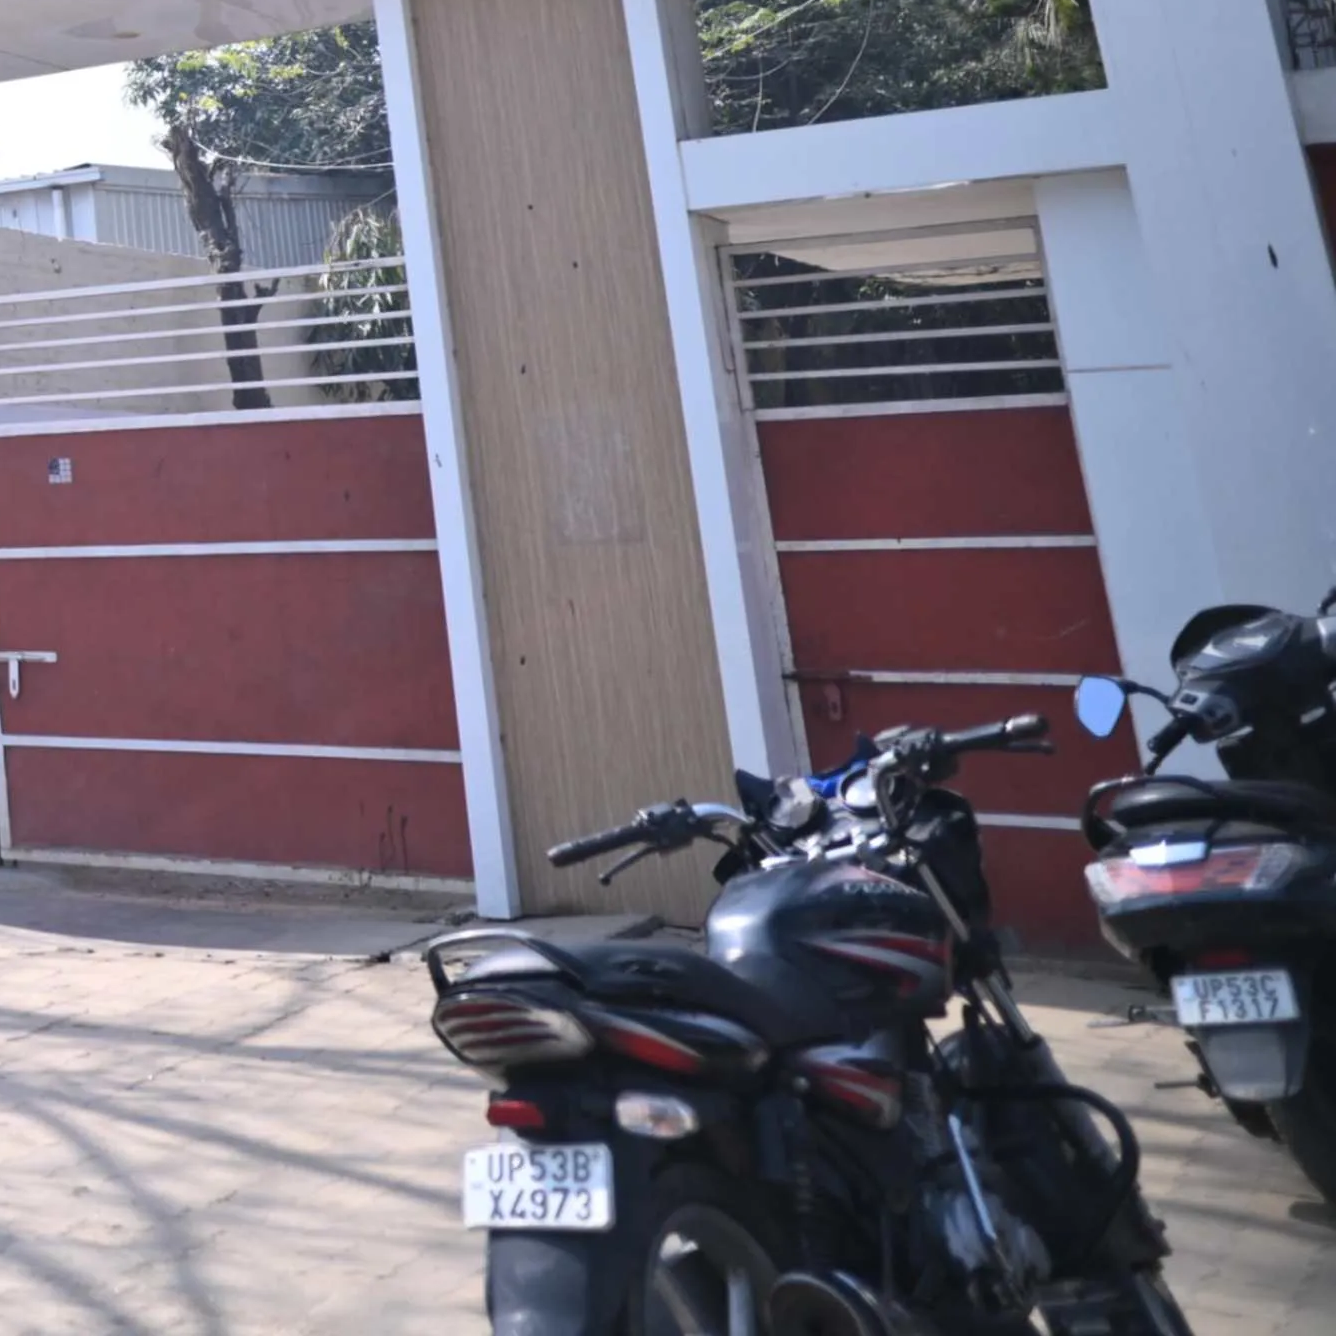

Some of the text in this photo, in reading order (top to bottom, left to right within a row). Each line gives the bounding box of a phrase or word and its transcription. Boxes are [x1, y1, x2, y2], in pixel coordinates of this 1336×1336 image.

[1192, 974, 1277, 1001] UP53C
[488, 1150, 592, 1183] UP53B
[489, 1187, 592, 1221] X4973
